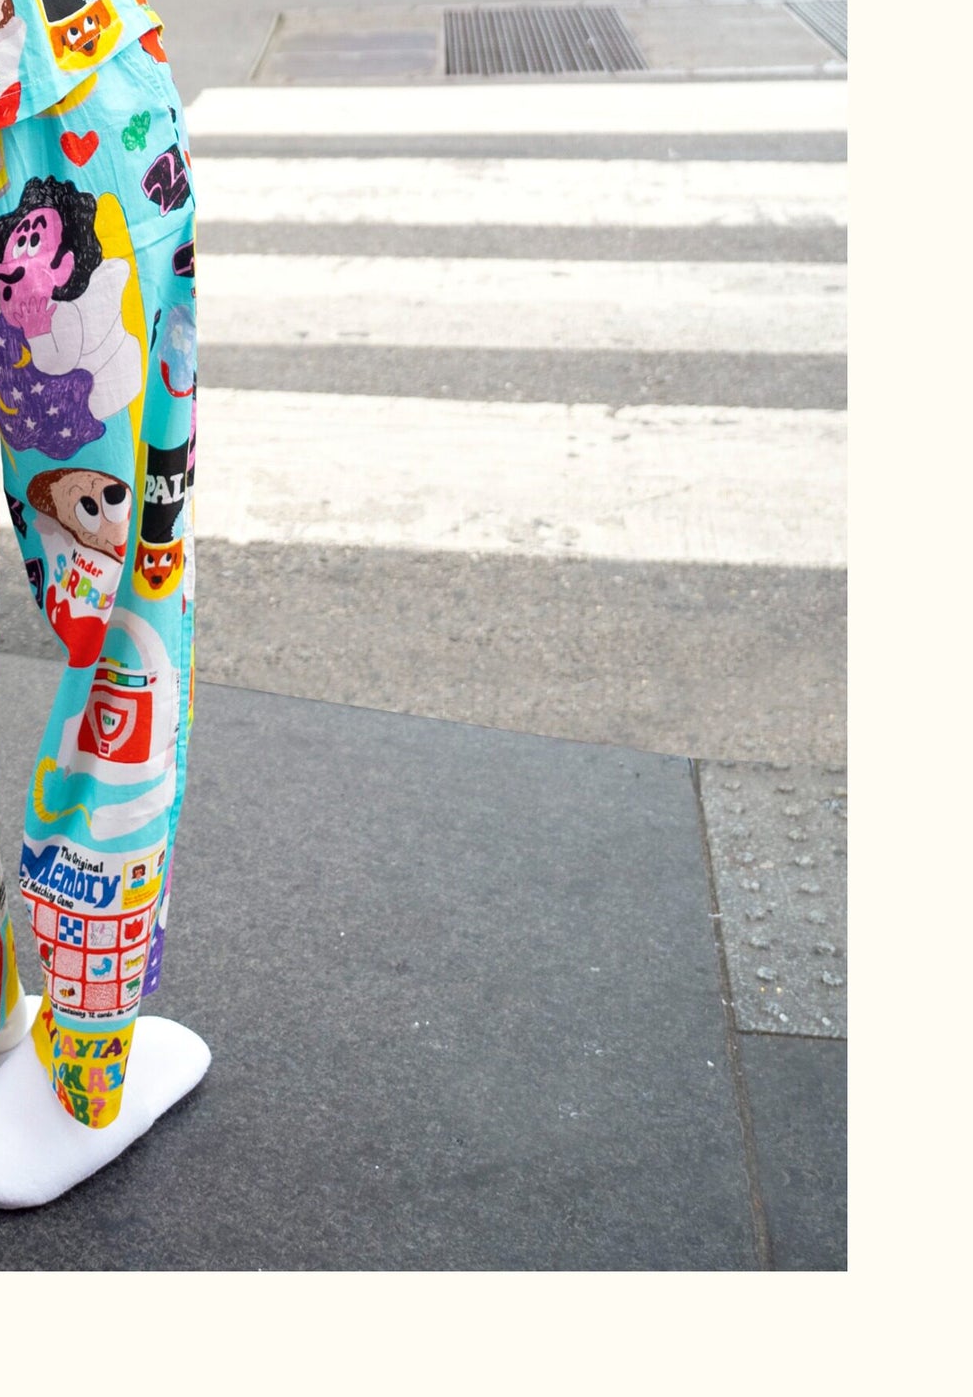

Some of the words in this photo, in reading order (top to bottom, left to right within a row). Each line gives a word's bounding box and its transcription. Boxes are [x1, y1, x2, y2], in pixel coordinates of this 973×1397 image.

[144, 472, 185, 505] PAL
[71, 548, 103, 578] Kinder
[61, 846, 71, 861] The
[71, 852, 104, 873] Original
[19, 842, 122, 909] Memory
[30, 881, 56, 903] Matching
